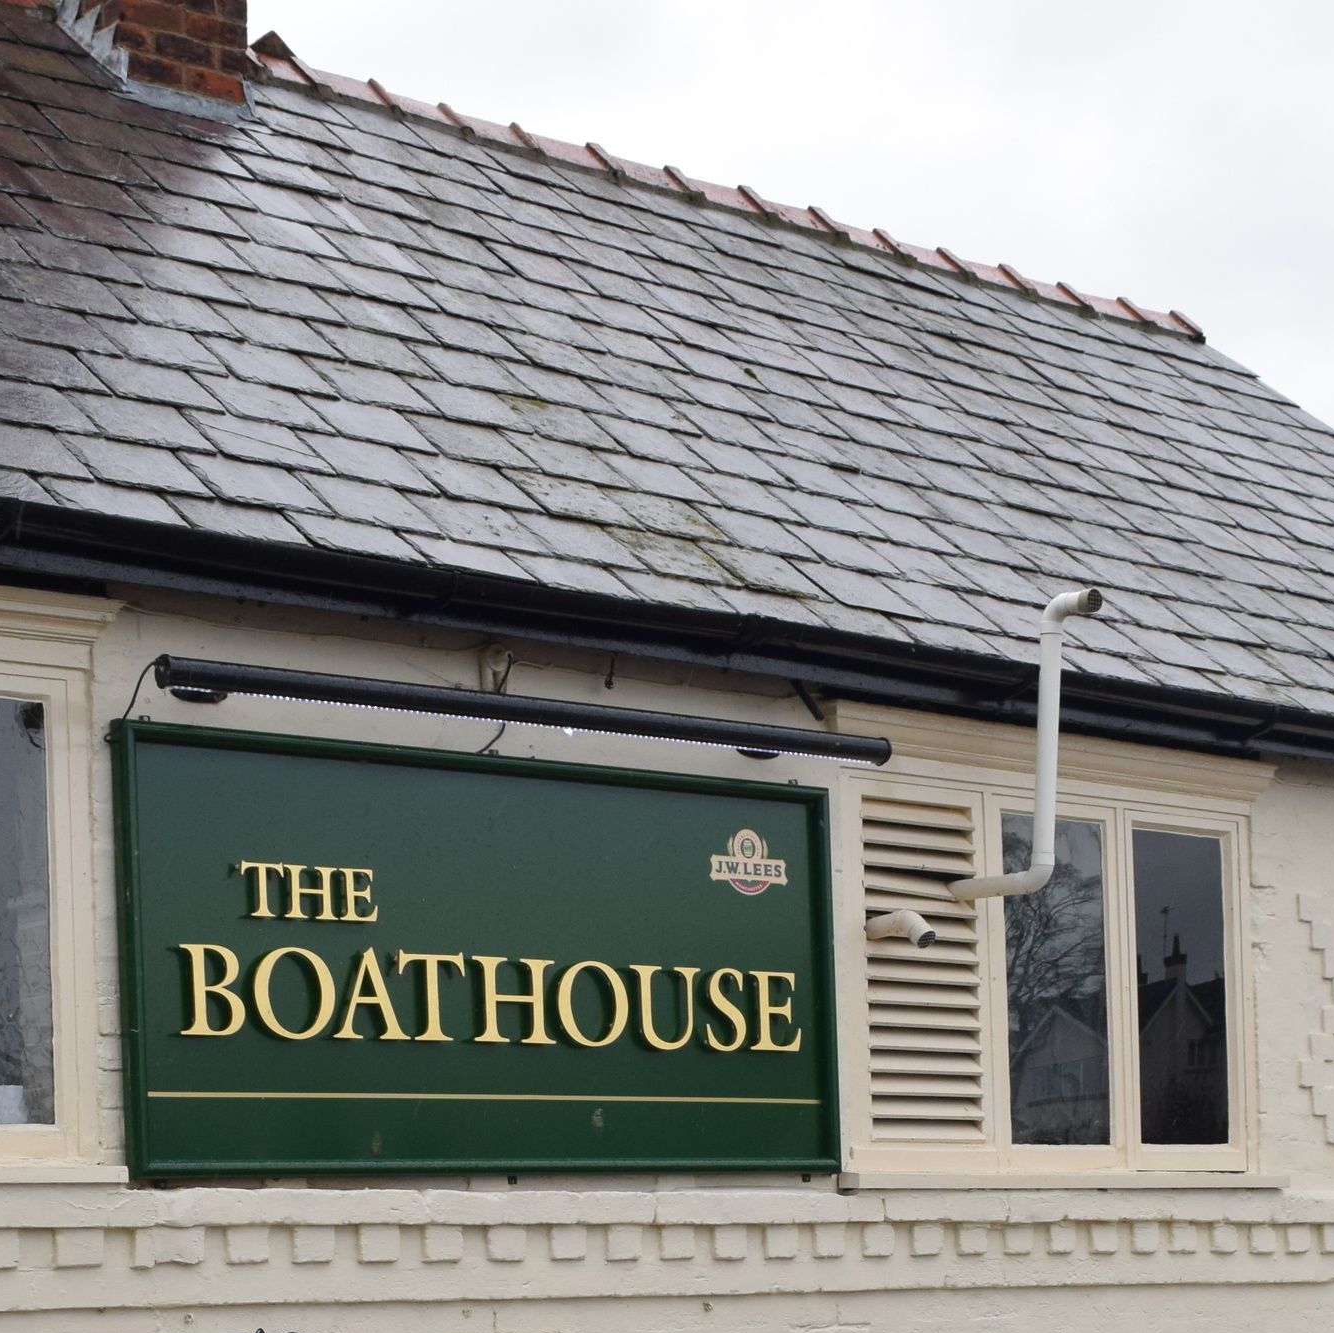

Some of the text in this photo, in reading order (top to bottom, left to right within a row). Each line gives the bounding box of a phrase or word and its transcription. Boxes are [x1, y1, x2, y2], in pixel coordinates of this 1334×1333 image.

[240, 860, 379, 922] THE
[743, 862, 782, 878] LEES
[179, 943, 803, 1052] BOATHOUSE
